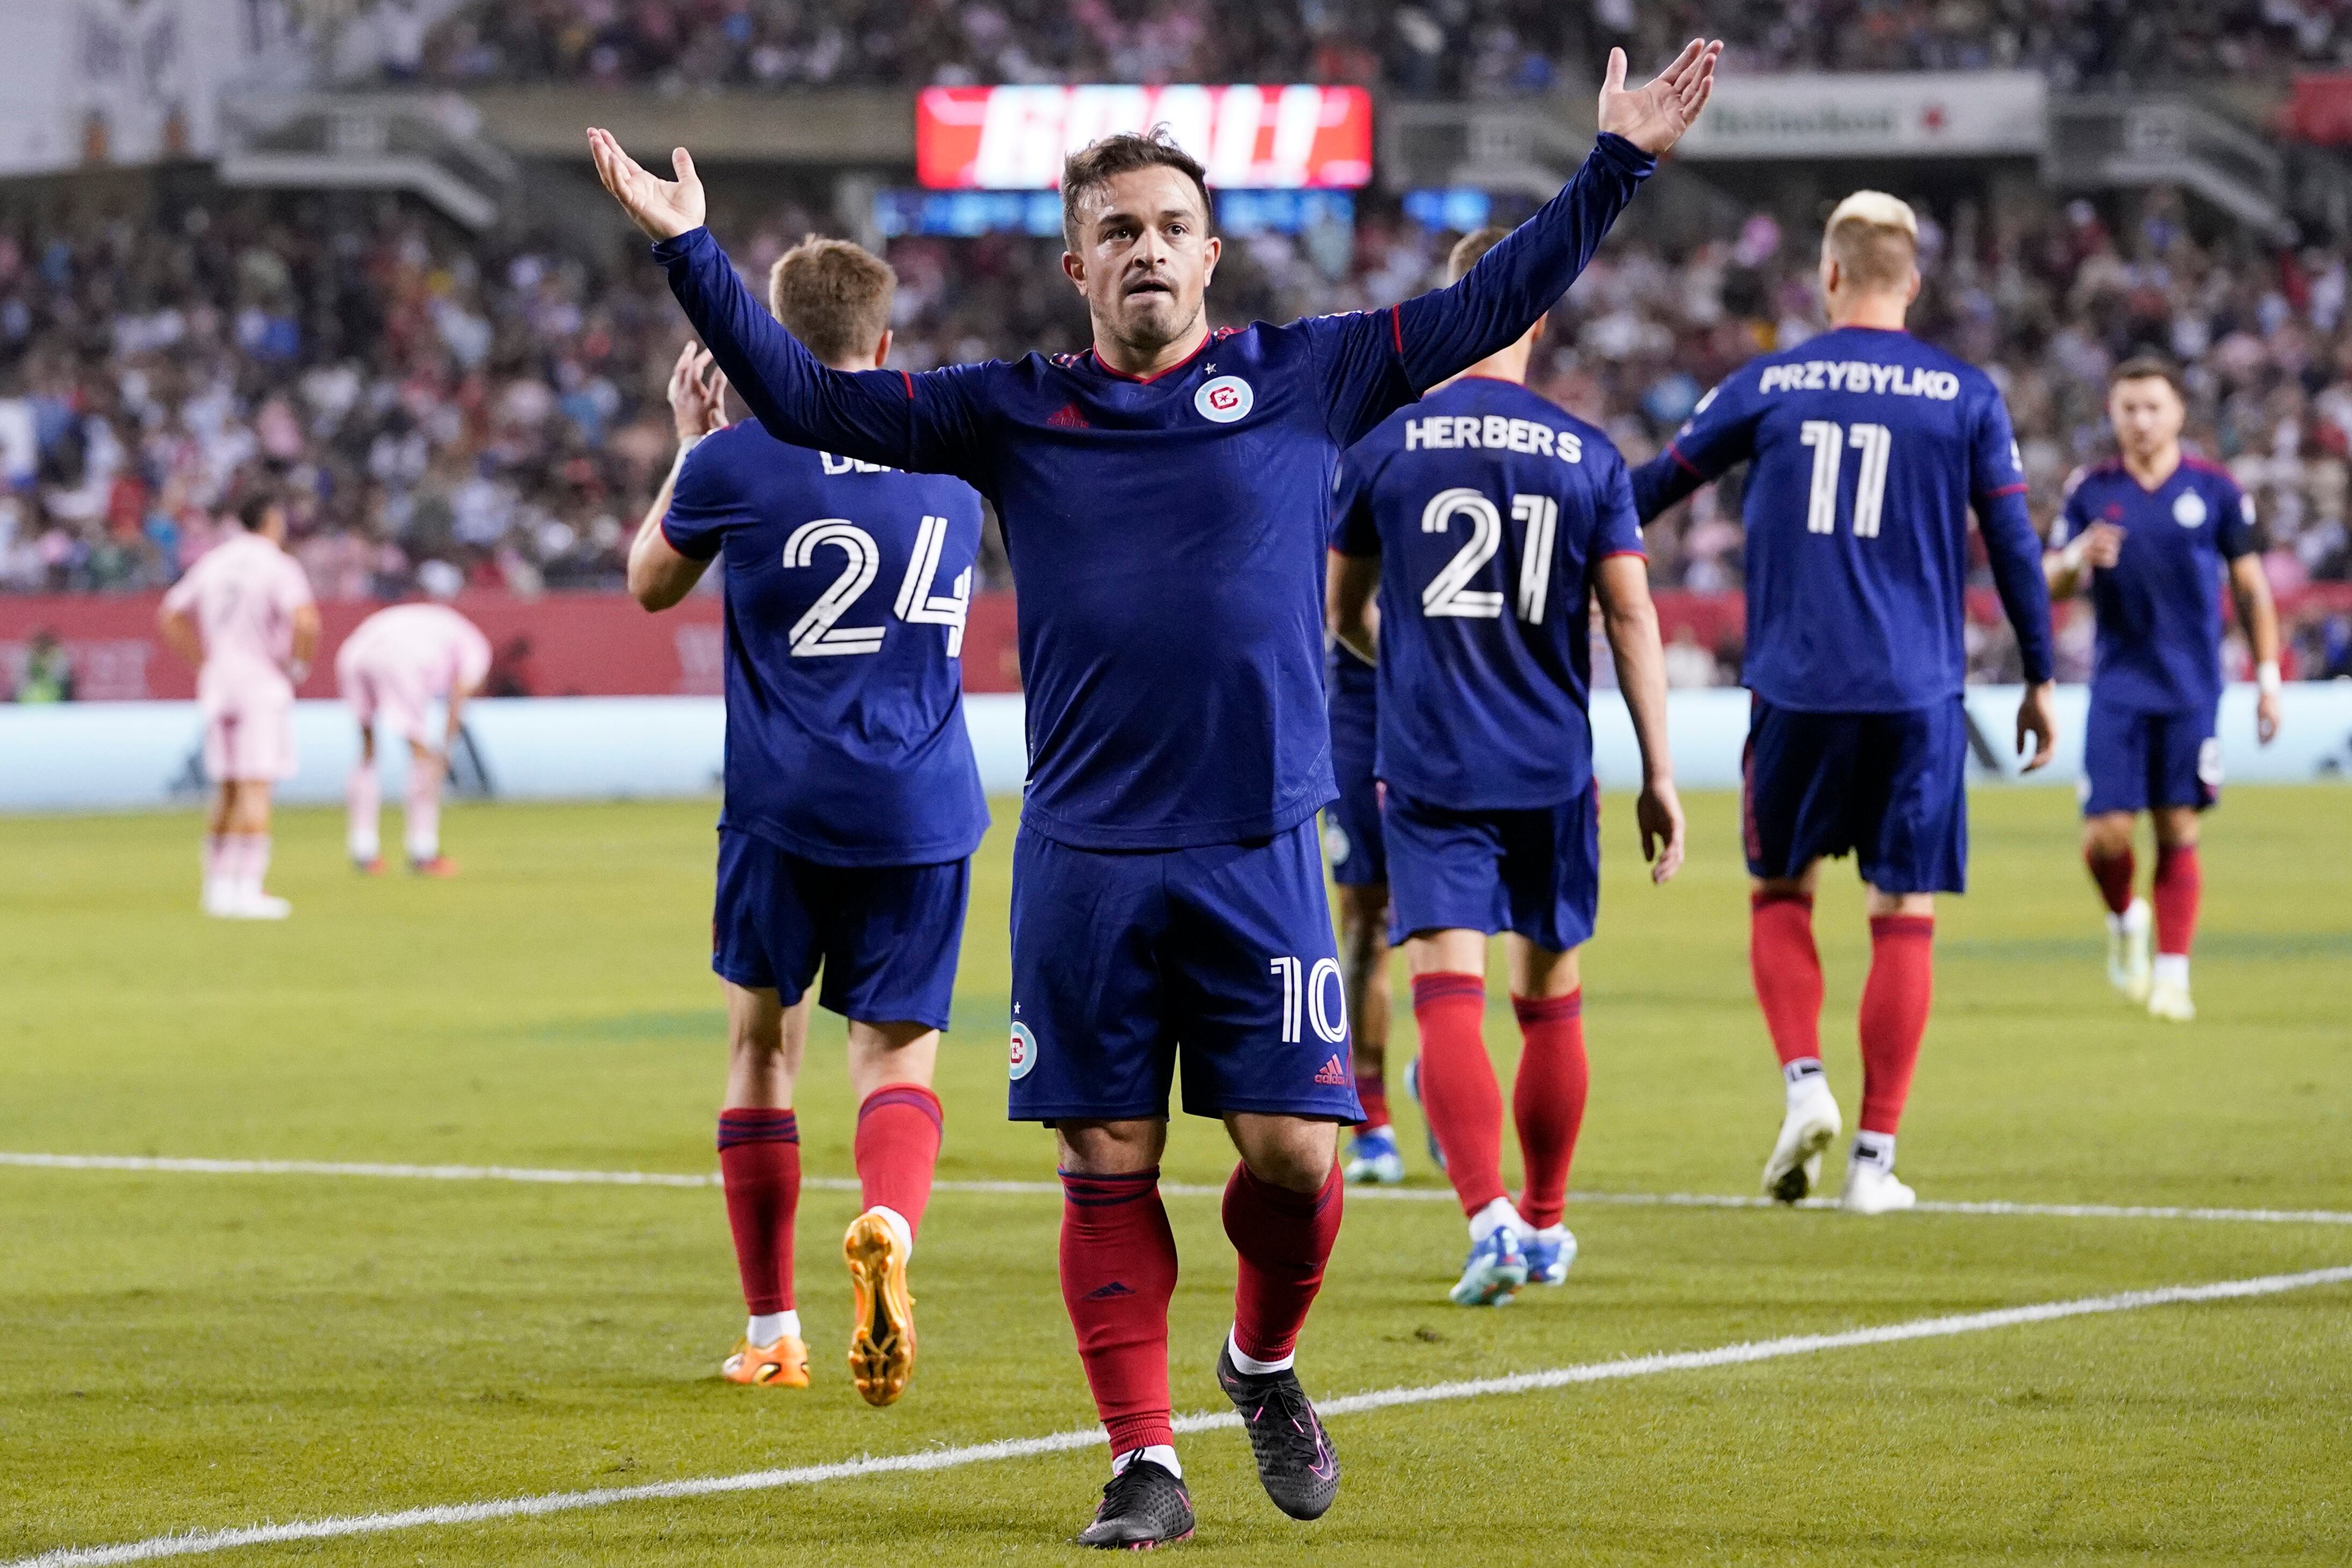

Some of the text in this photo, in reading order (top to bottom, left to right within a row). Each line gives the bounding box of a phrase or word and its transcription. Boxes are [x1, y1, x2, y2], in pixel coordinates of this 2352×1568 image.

[1759, 361, 1960, 400] PRZYBYLKO
[1405, 415, 1583, 464] HERBERS
[1800, 420, 1891, 538] 11
[782, 515, 972, 657] 24
[1421, 488, 1558, 625] 21
[1270, 956, 1347, 1044] 10
[1314, 1073, 1345, 1085] adidas
